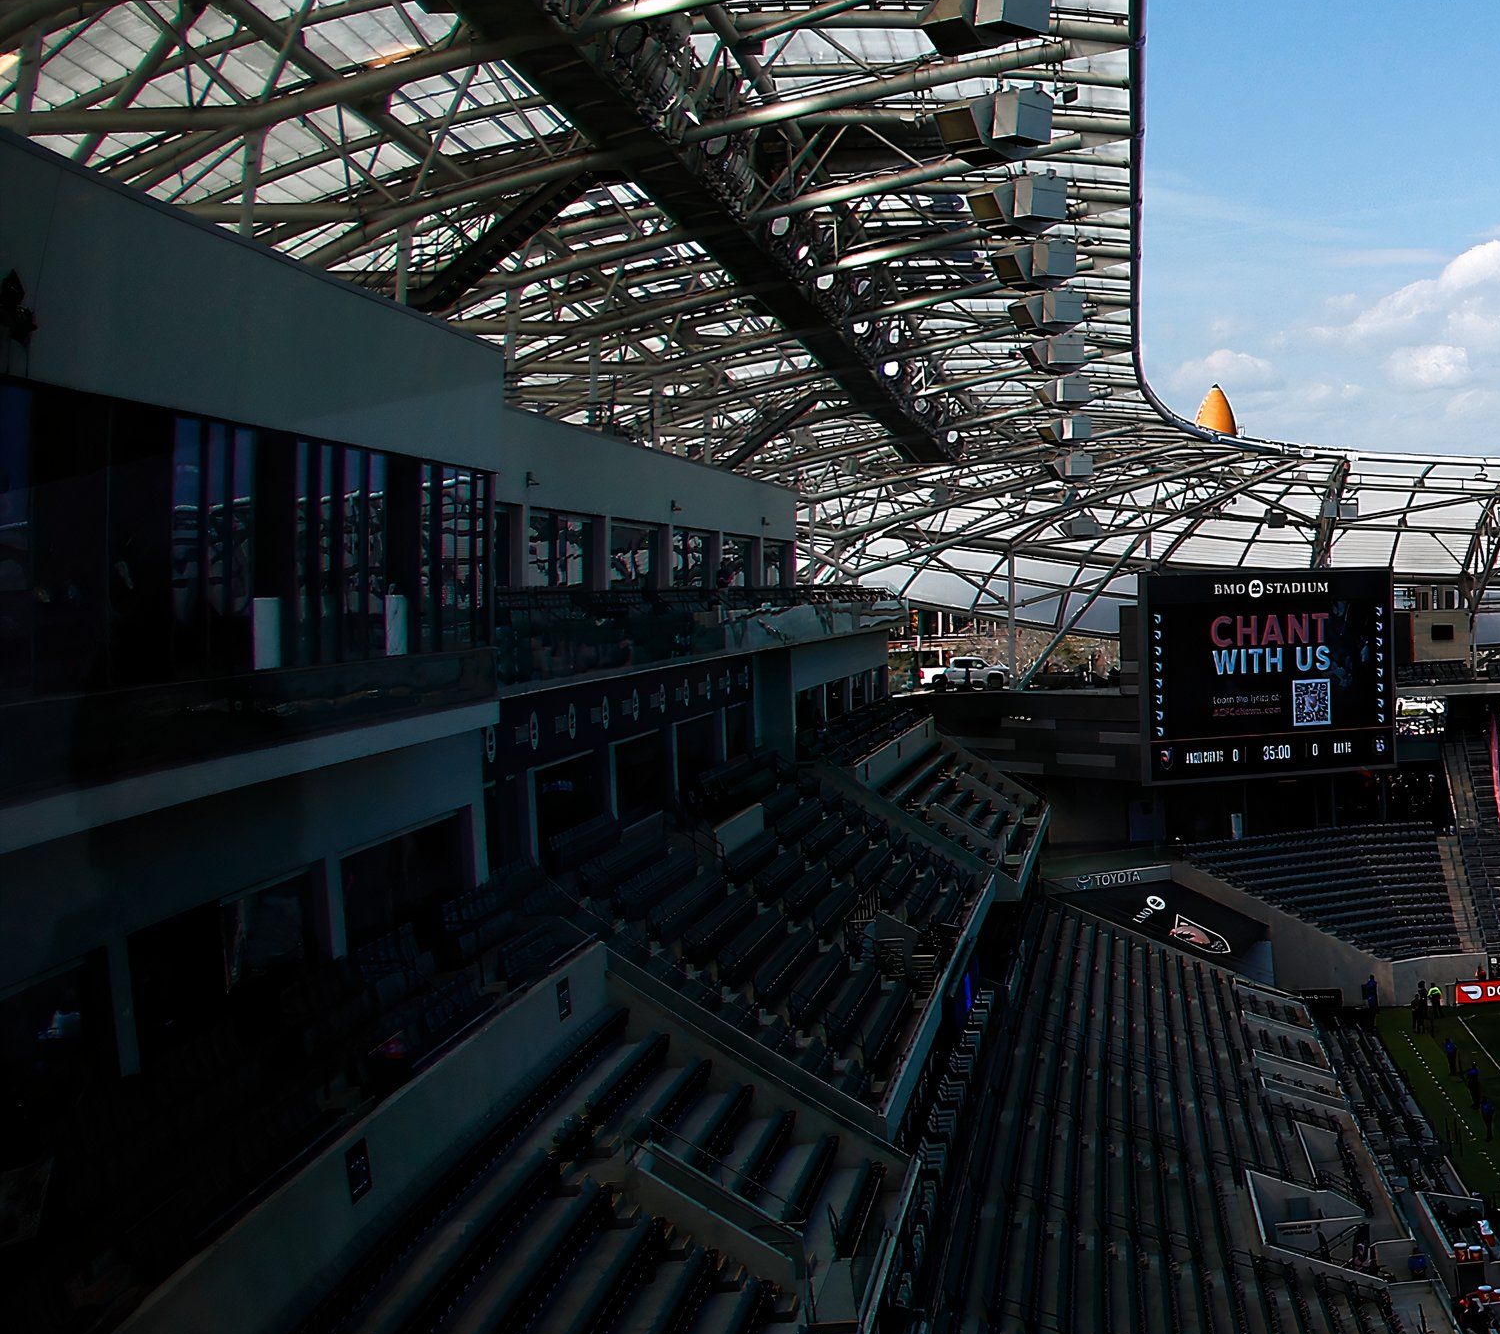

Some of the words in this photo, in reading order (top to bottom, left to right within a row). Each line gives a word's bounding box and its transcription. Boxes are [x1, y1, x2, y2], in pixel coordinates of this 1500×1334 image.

[1213, 584, 1246, 595] BMO
[1265, 581, 1329, 594] STADIUM
[1210, 613, 1329, 648] CHANT
[1212, 647, 1283, 675] WITH
[1295, 645, 1331, 671] US
[1232, 748, 1239, 762] 0
[1263, 744, 1291, 761] 35:00
[1312, 743, 1319, 756] 0
[1094, 871, 1141, 886] TOYOTA
